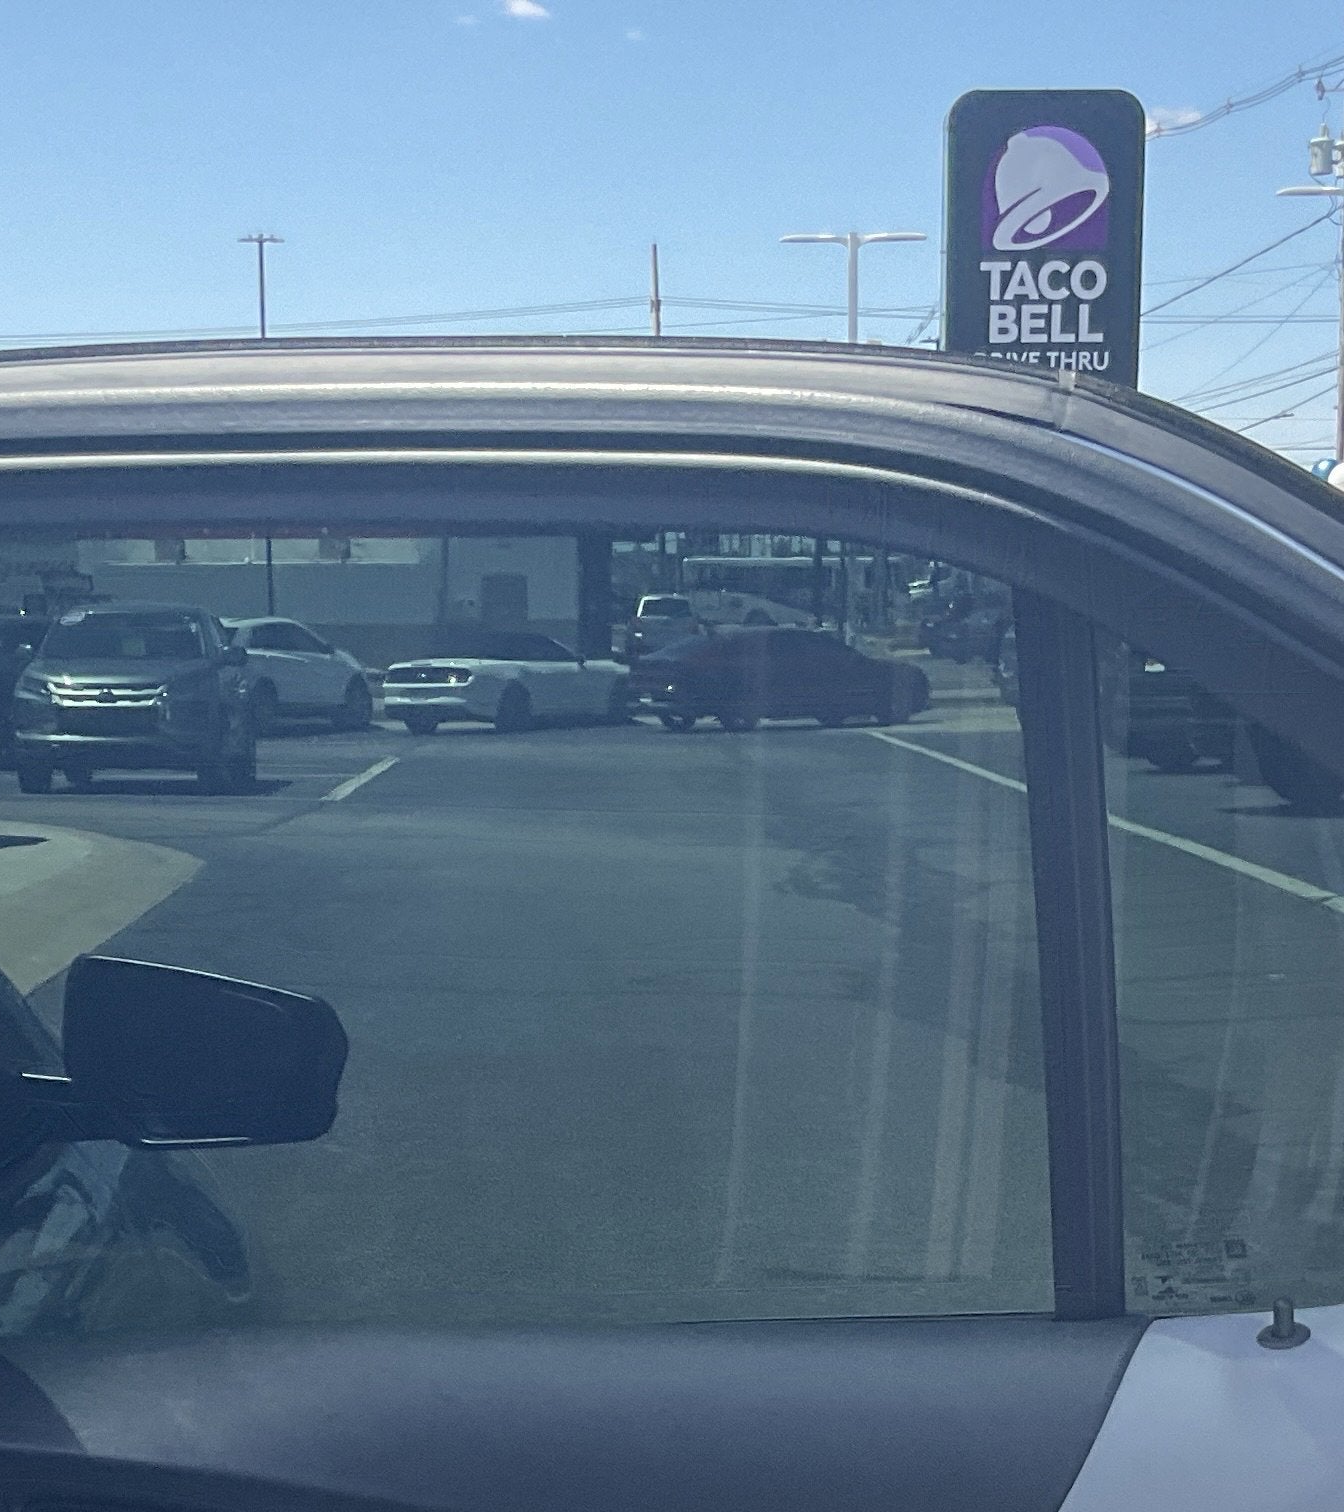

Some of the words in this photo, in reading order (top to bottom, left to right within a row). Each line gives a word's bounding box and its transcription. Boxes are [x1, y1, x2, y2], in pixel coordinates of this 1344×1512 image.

[980, 260, 1107, 300] TACO
[989, 303, 1104, 344] BELL
[1046, 351, 1110, 371] THRU
